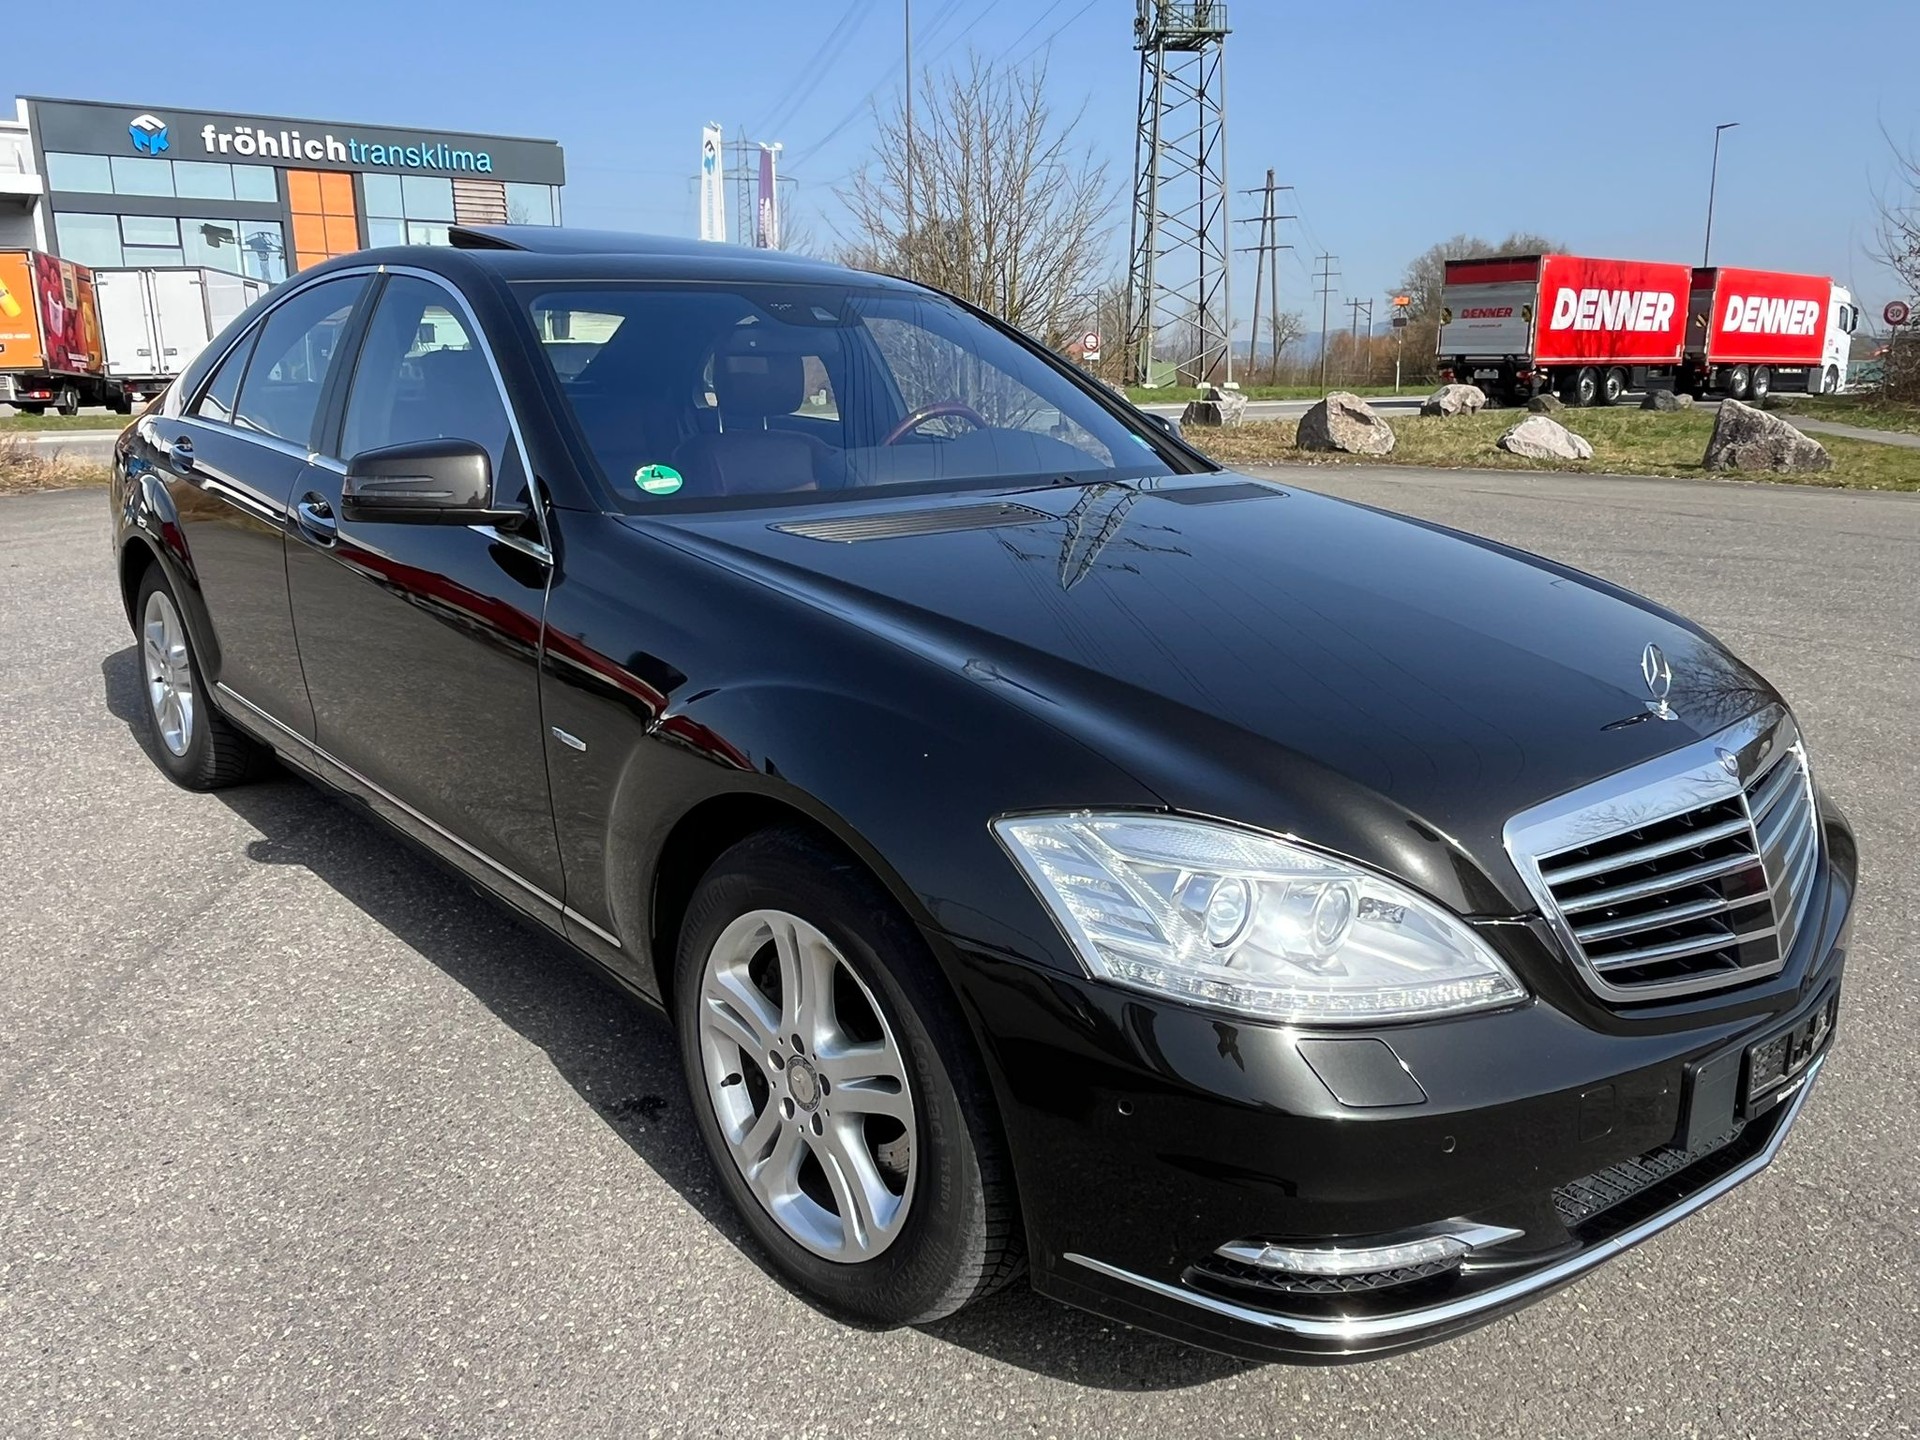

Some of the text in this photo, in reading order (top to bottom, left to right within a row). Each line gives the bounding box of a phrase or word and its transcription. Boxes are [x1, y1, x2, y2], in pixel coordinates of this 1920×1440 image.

[1461, 306, 1513, 319] DENNER
[1550, 286, 1676, 332] DENNER
[1722, 294, 1820, 336] DENNER
[651, 466, 664, 479] 4
